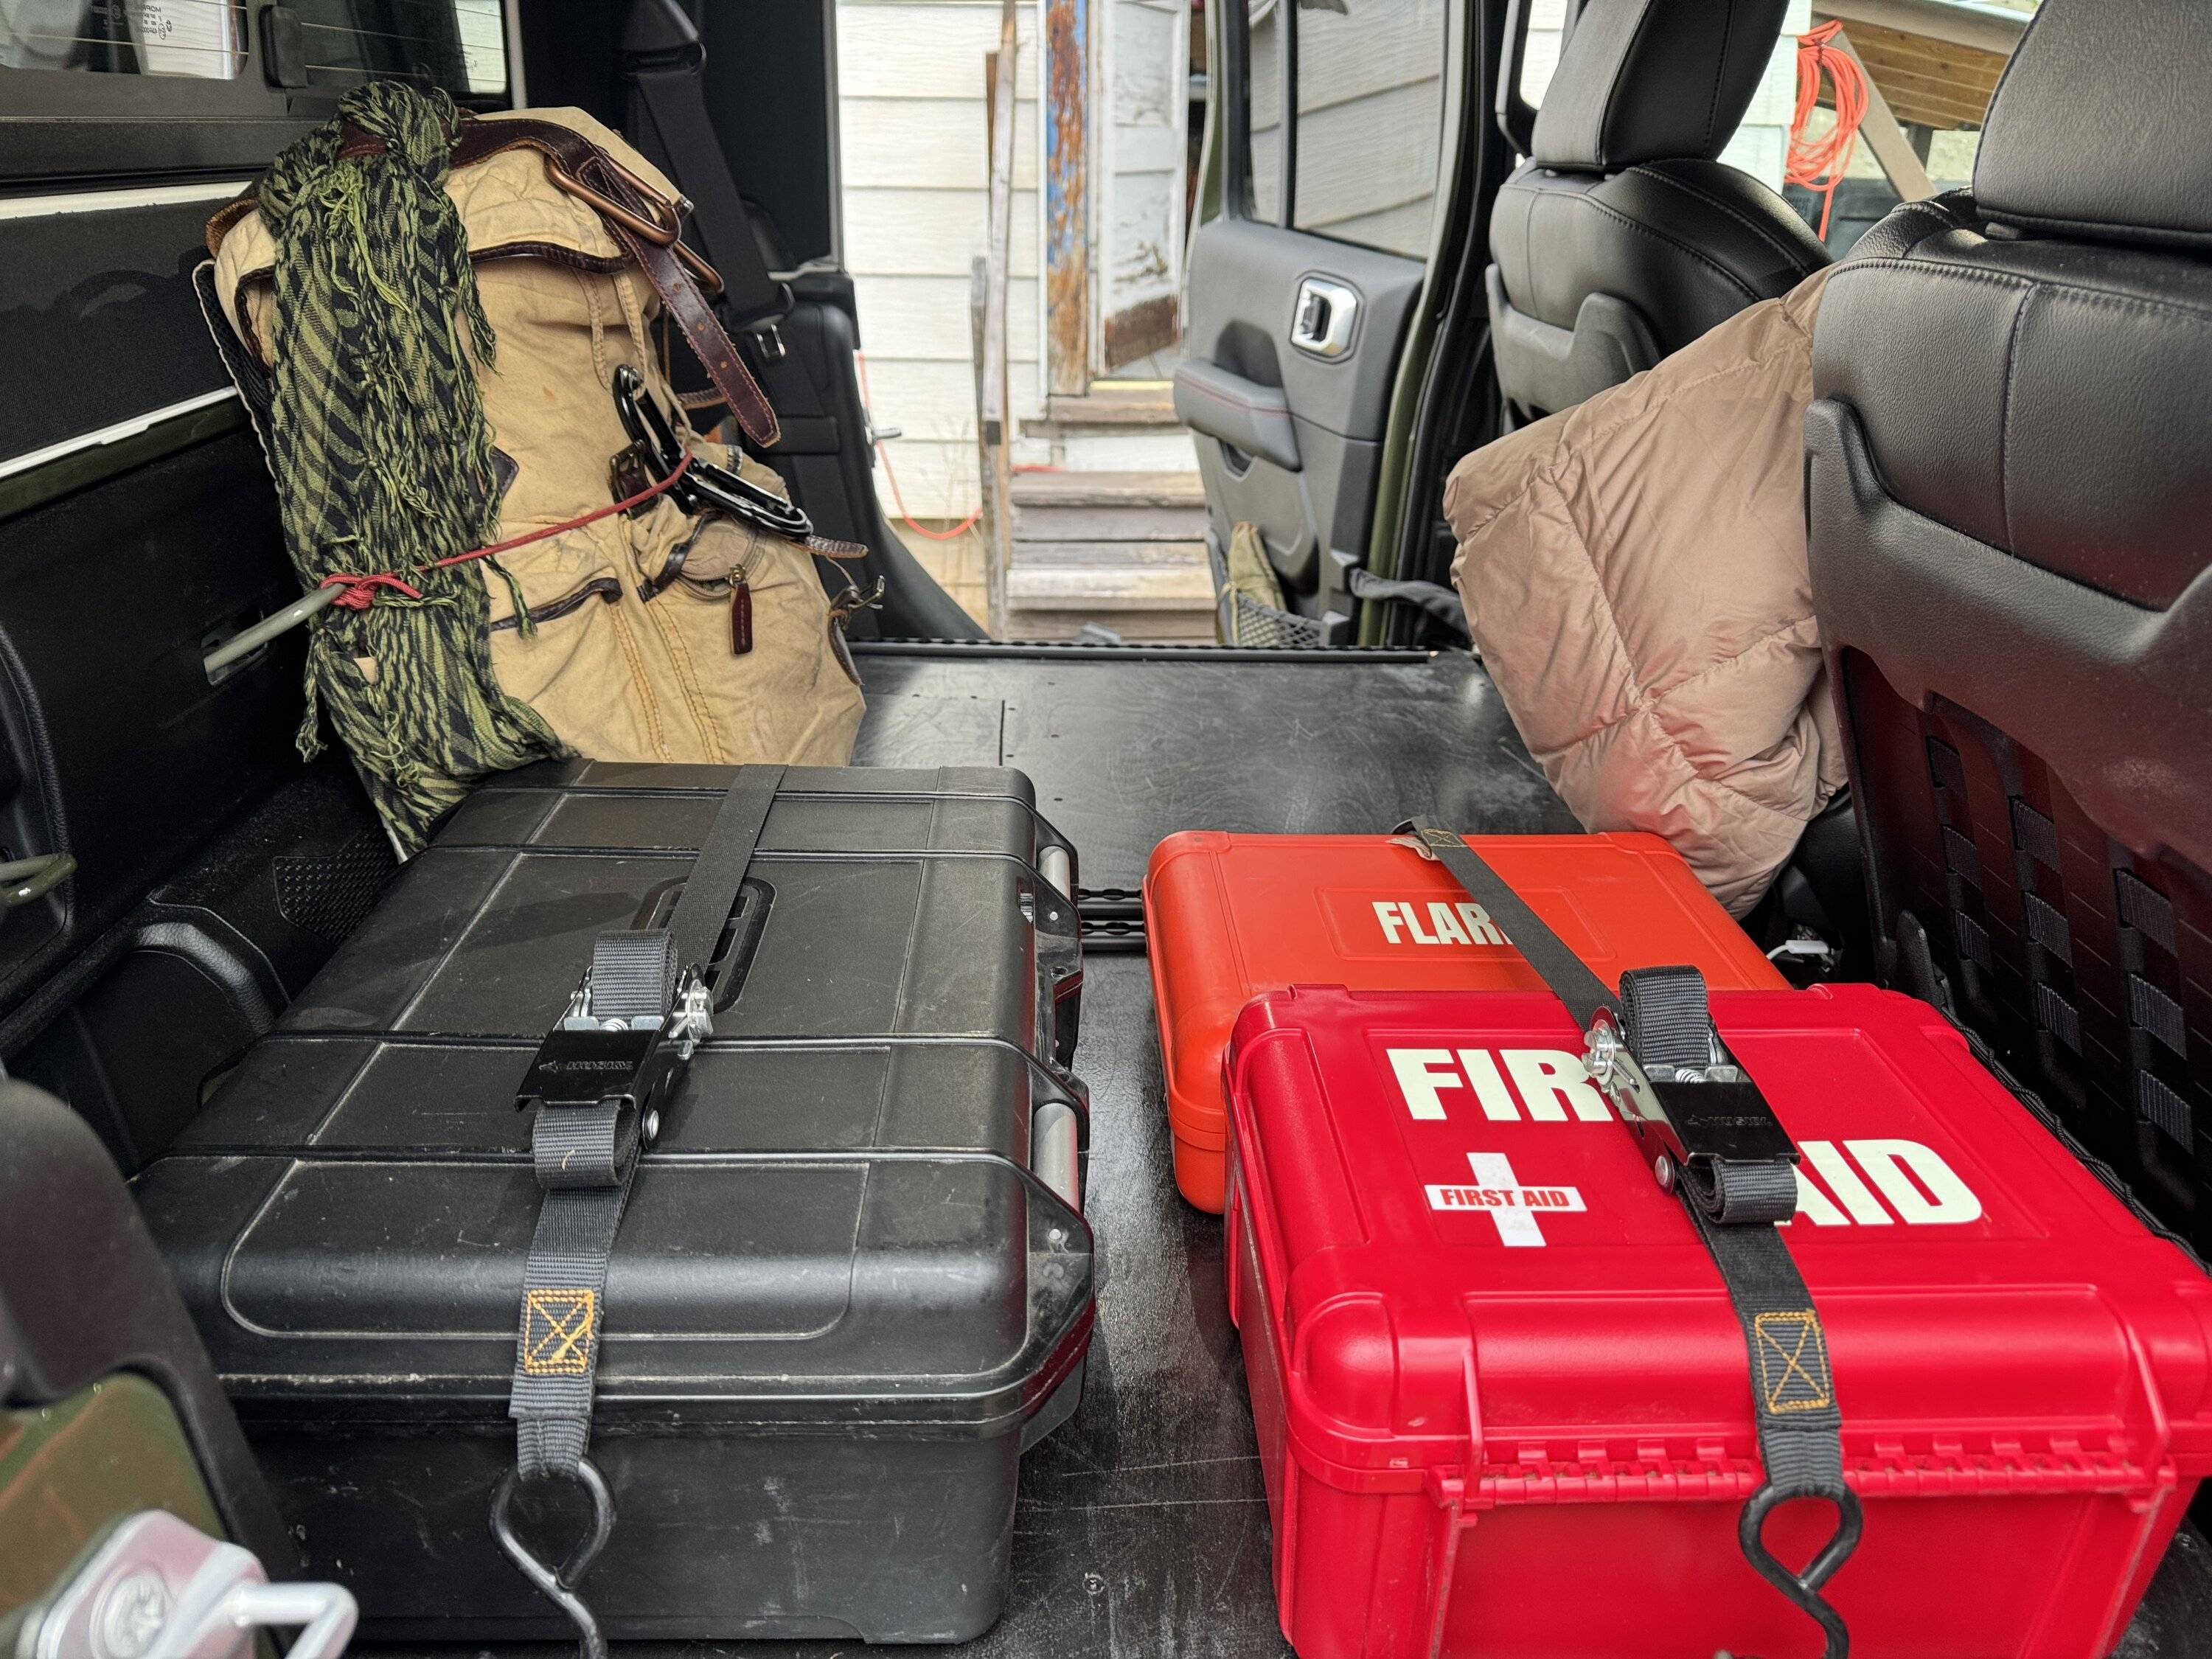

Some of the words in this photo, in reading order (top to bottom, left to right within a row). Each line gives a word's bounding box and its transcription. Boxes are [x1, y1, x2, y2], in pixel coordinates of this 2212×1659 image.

[1372, 902, 1512, 945] FLAR
[1386, 1049, 1614, 1121] FIR
[1441, 1189, 1515, 1206] FIRST
[1523, 1191, 1570, 1206] AID
